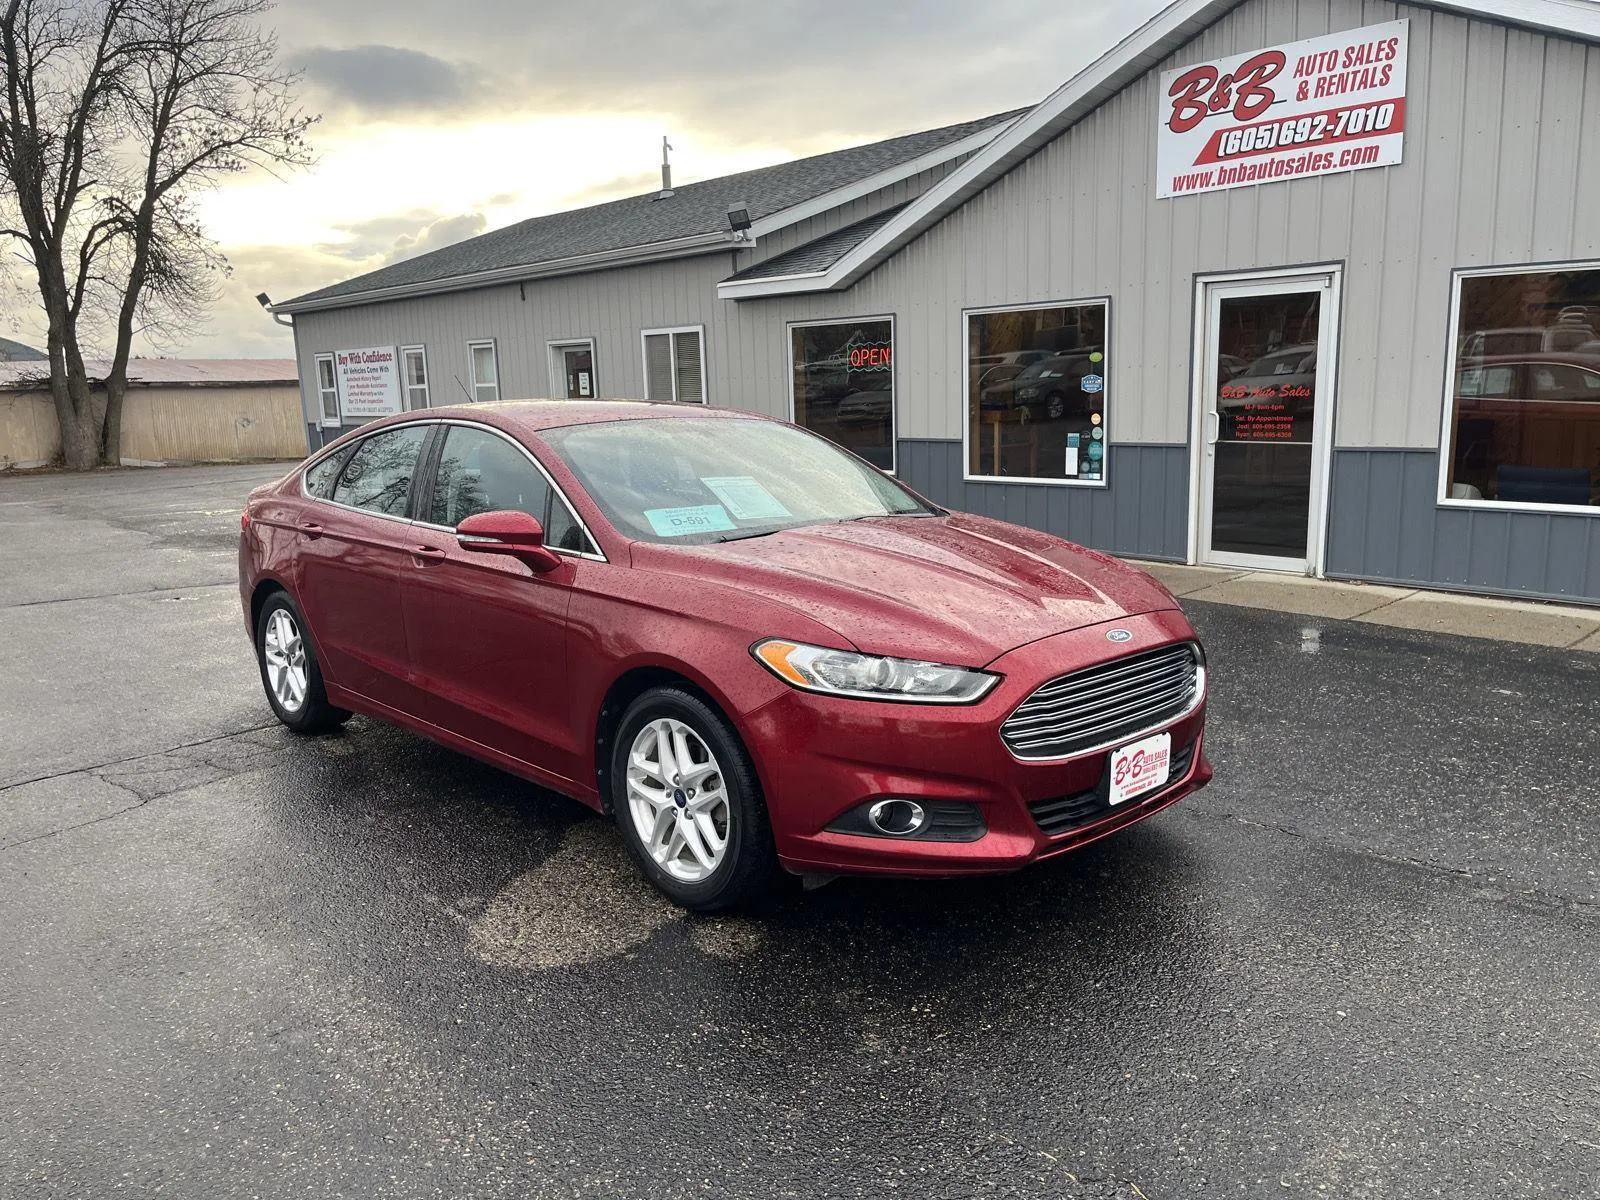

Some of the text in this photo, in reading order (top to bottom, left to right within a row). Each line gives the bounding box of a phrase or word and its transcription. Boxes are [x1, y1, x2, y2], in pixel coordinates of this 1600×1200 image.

[1293, 37, 1399, 79] AUTO SALES
[1167, 50, 1287, 134] B&B
[1295, 63, 1393, 102] & RENTALS
[1216, 103, 1395, 158] (605)692-7010
[1172, 144, 1380, 192] www.bnbautosales.com
[338, 350, 393, 367] Buy With Confidence
[349, 367, 367, 375] Vehicles
[366, 366, 379, 374] Come
[379, 365, 390, 373] With
[850, 347, 891, 367] OPEN
[1279, 384, 1311, 397] Sales
[1115, 749, 1145, 785] B&B
[1143, 748, 1168, 764] AUTO SALES
